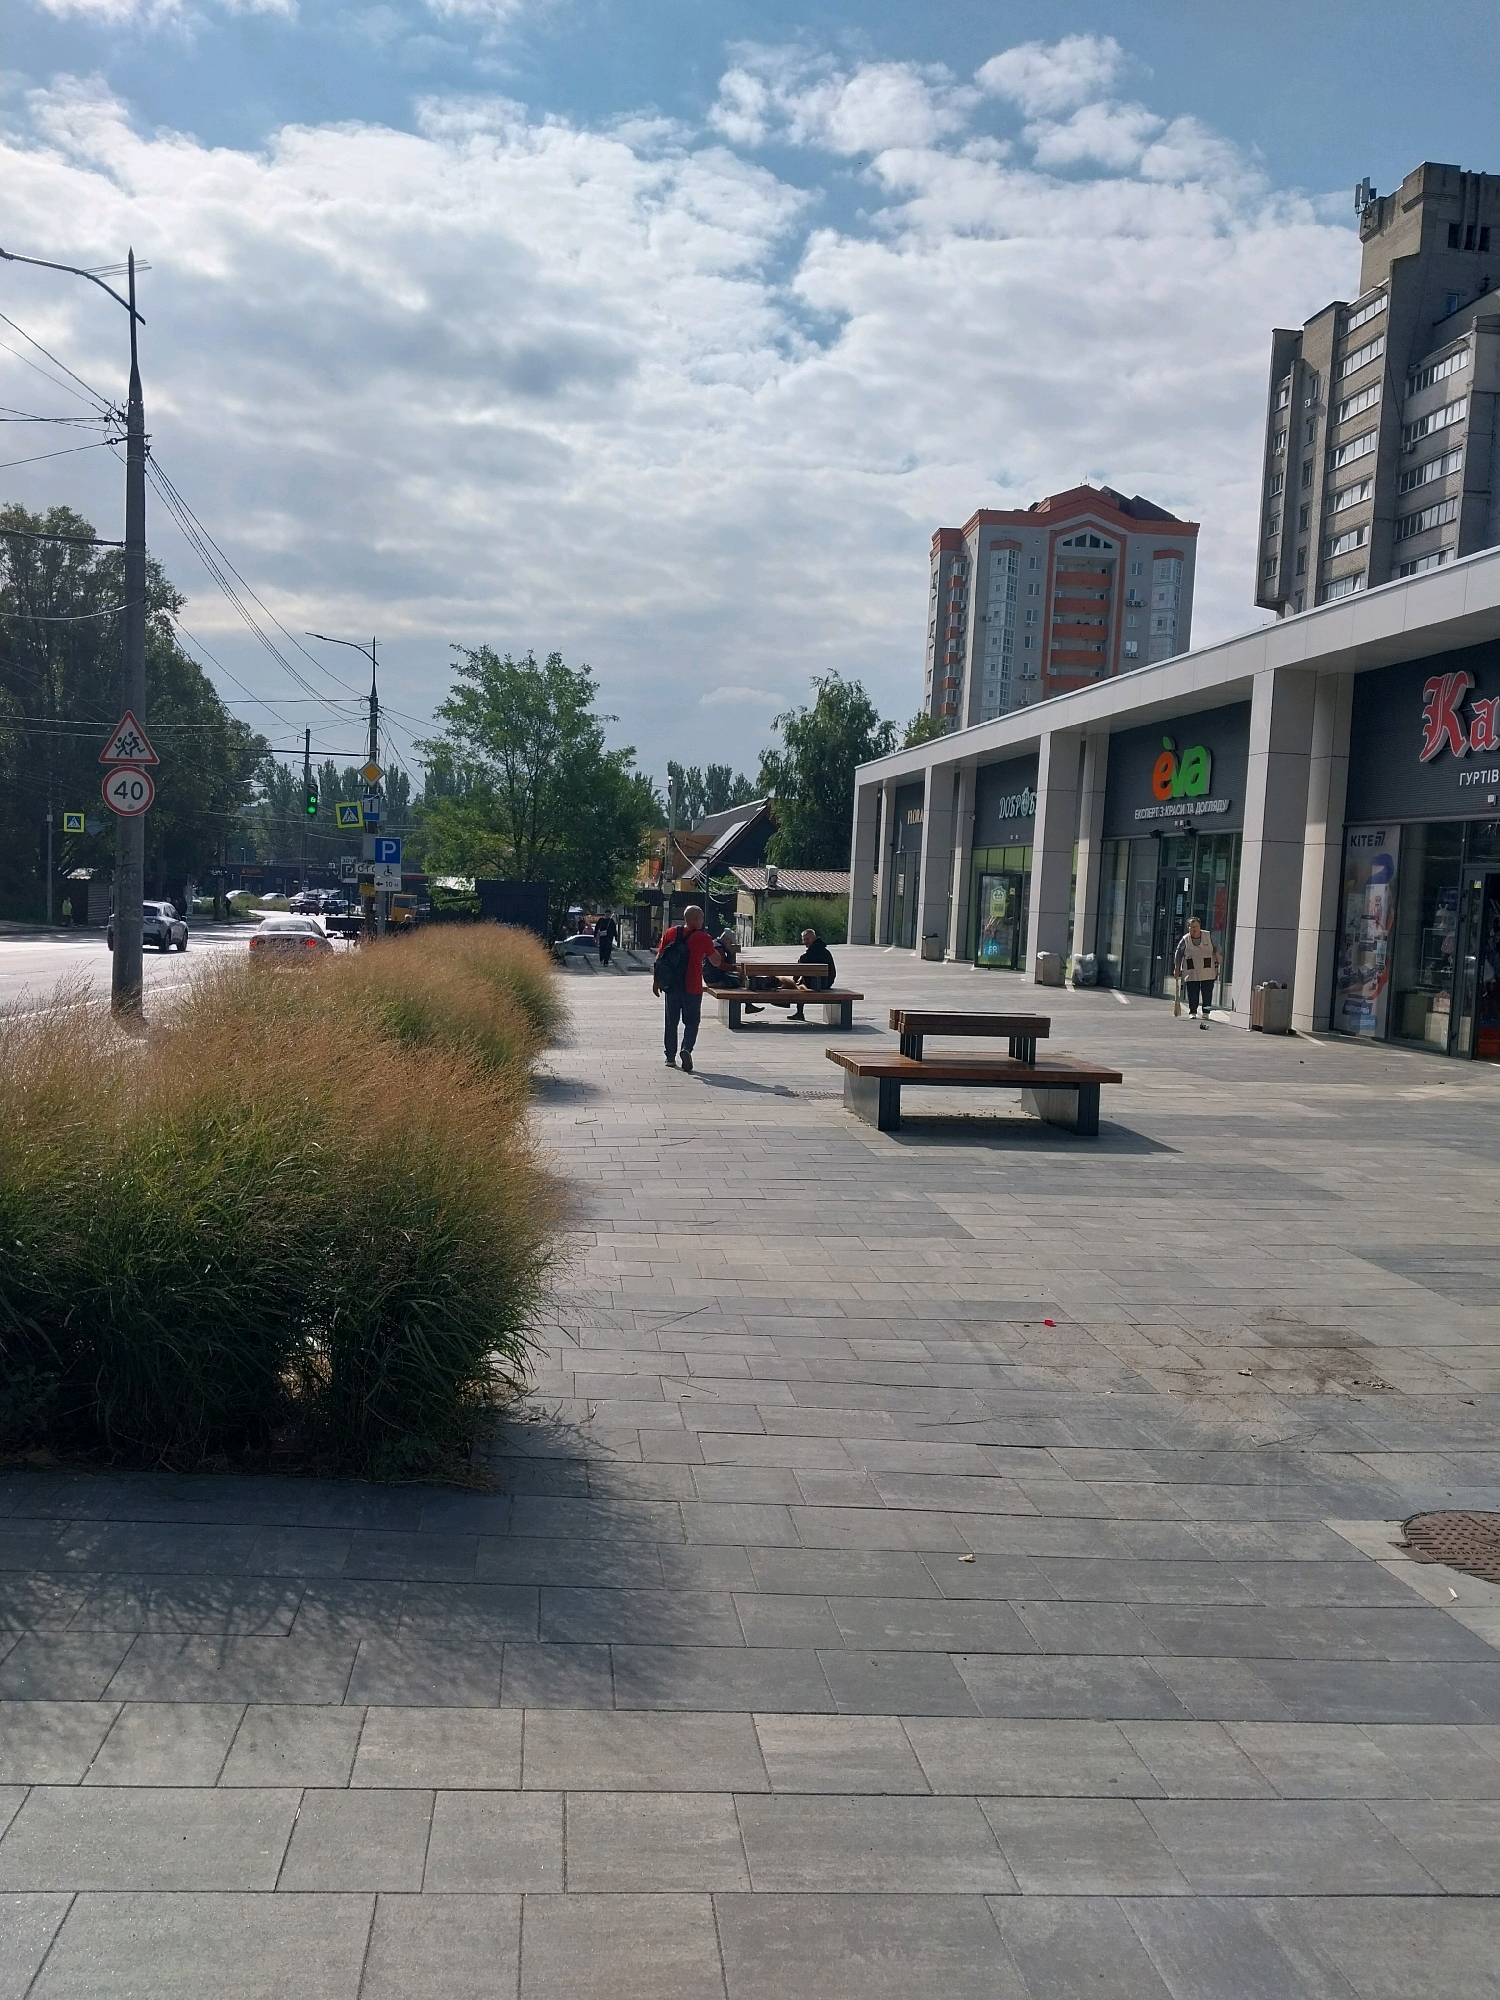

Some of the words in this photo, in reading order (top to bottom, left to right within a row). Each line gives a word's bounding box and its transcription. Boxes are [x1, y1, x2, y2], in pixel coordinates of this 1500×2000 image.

[113, 780, 144, 801] 40
[999, 787, 1037, 819] ДОБРОБ
[1134, 806, 1159, 819] ЕКСПЕРТ
[1159, 806, 1165, 817] З
[1164, 803, 1185, 816] КРАСИ
[1186, 802, 1195, 814] ТА
[1195, 799, 1229, 815] ДОГЛЯДУ
[381, 840, 397, 862] P
[385, 880, 393, 888] 10
